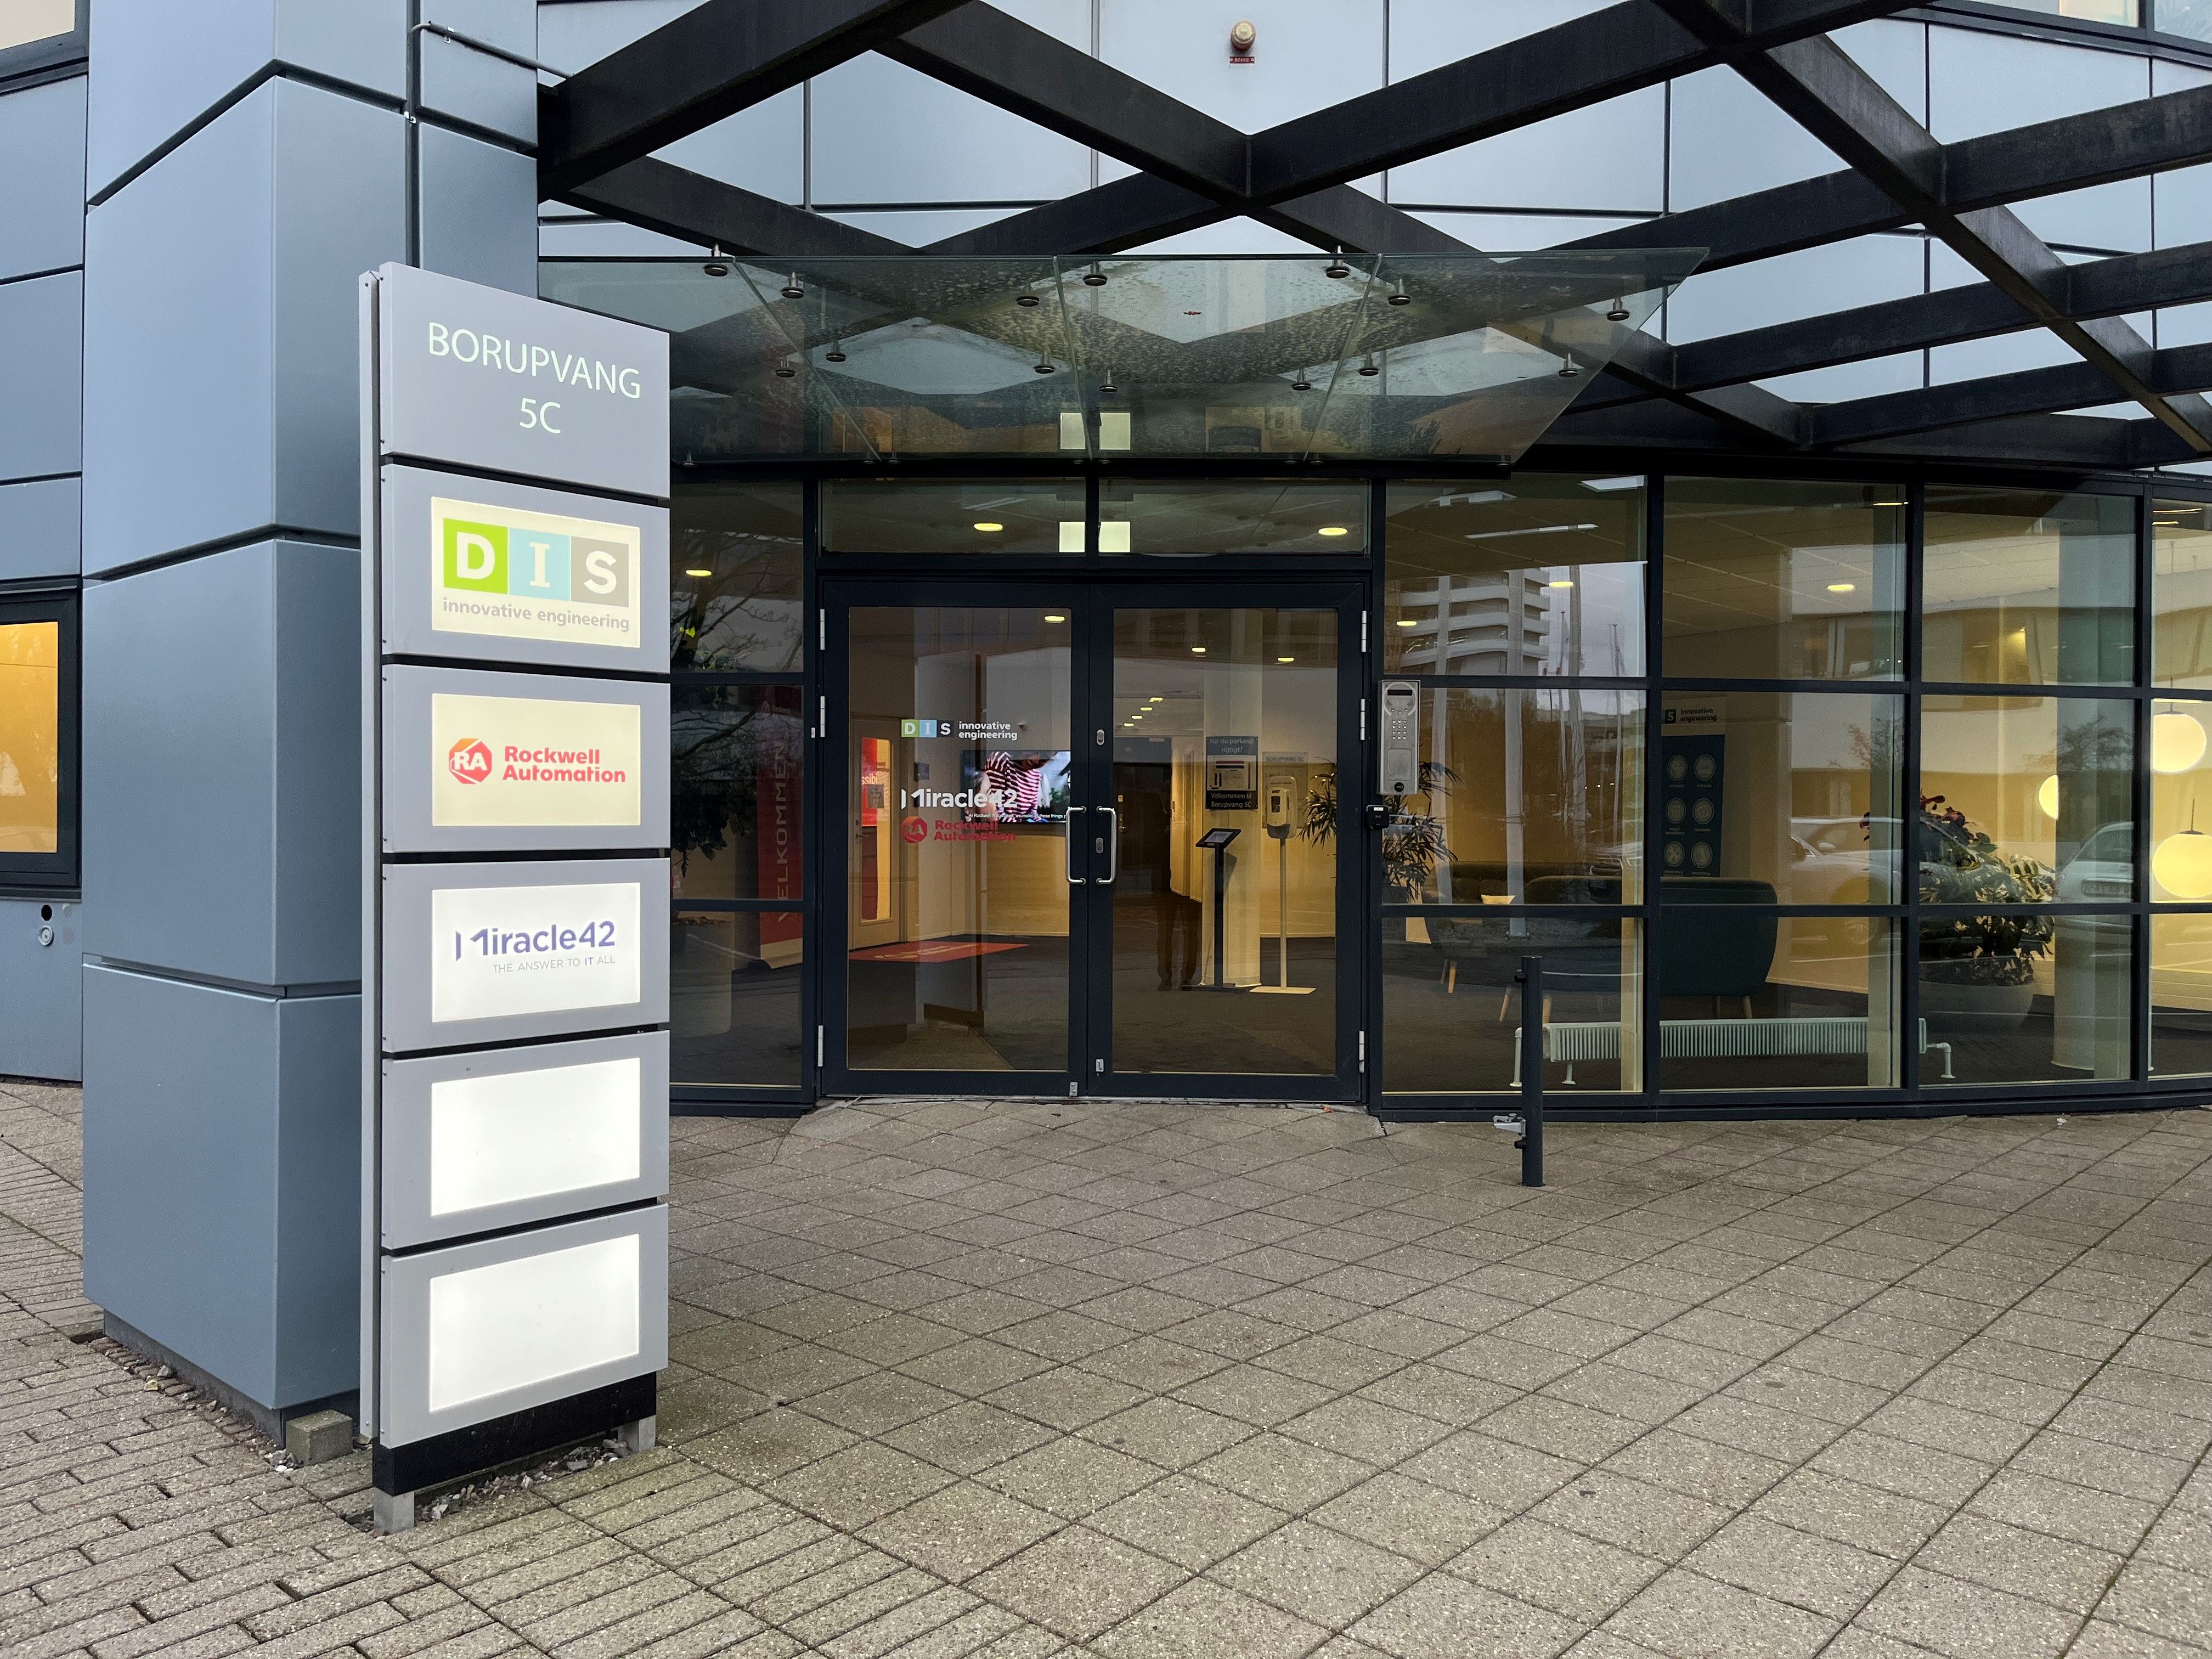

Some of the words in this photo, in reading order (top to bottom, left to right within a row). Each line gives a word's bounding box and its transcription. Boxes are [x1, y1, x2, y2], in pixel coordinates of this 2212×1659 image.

[428, 321, 641, 399] BORUPVANG
[519, 397, 561, 434] 5C
[443, 597, 532, 620] innovative
[537, 610, 630, 633] engineering
[958, 720, 1011, 730] innovative
[958, 731, 1018, 741] engineering
[454, 751, 488, 771] RA
[504, 746, 601, 765] Rockwell
[502, 765, 627, 783] Automation
[934, 820, 999, 831] Rockwell
[933, 831, 1018, 842] Automation
[455, 920, 616, 962] Miracle42
[493, 963, 514, 974] THE
[517, 960, 564, 971] ANSWER
[567, 958, 581, 967] TO
[584, 957, 594, 966] IT
[596, 956, 616, 965] ALL
